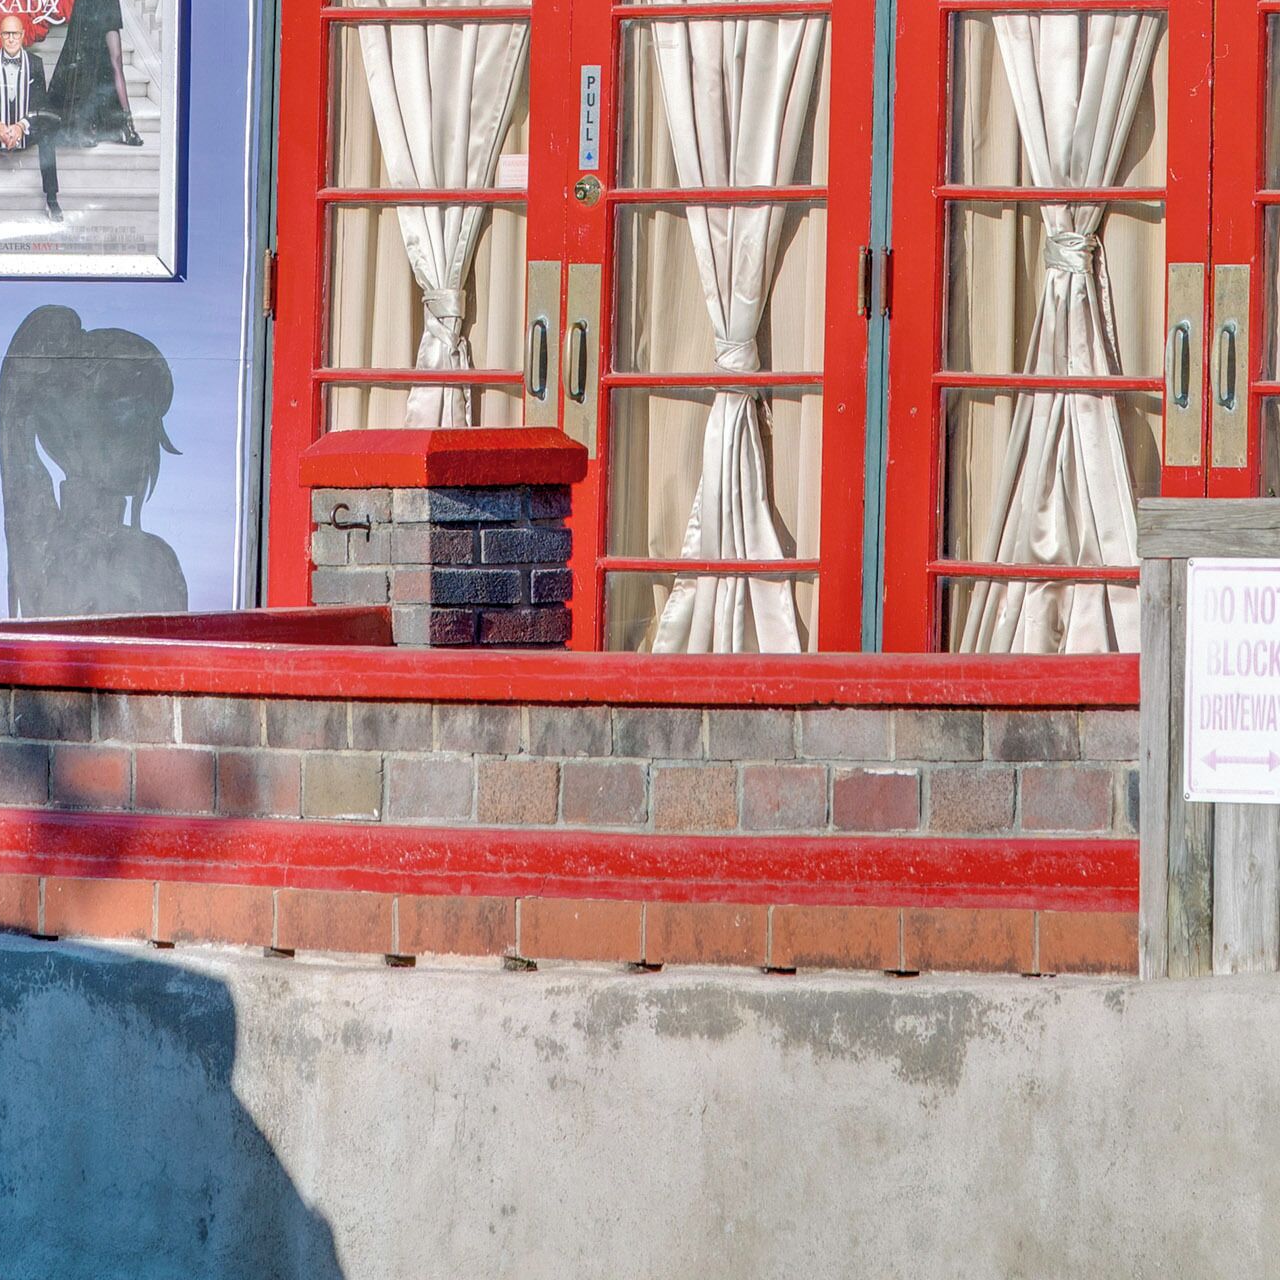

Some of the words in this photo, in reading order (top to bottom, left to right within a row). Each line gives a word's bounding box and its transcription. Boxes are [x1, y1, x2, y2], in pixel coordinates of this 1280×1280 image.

[586, 75, 596, 141] PULL
[32, 242, 53, 251] MAY
[1203, 585, 1235, 625] DO
